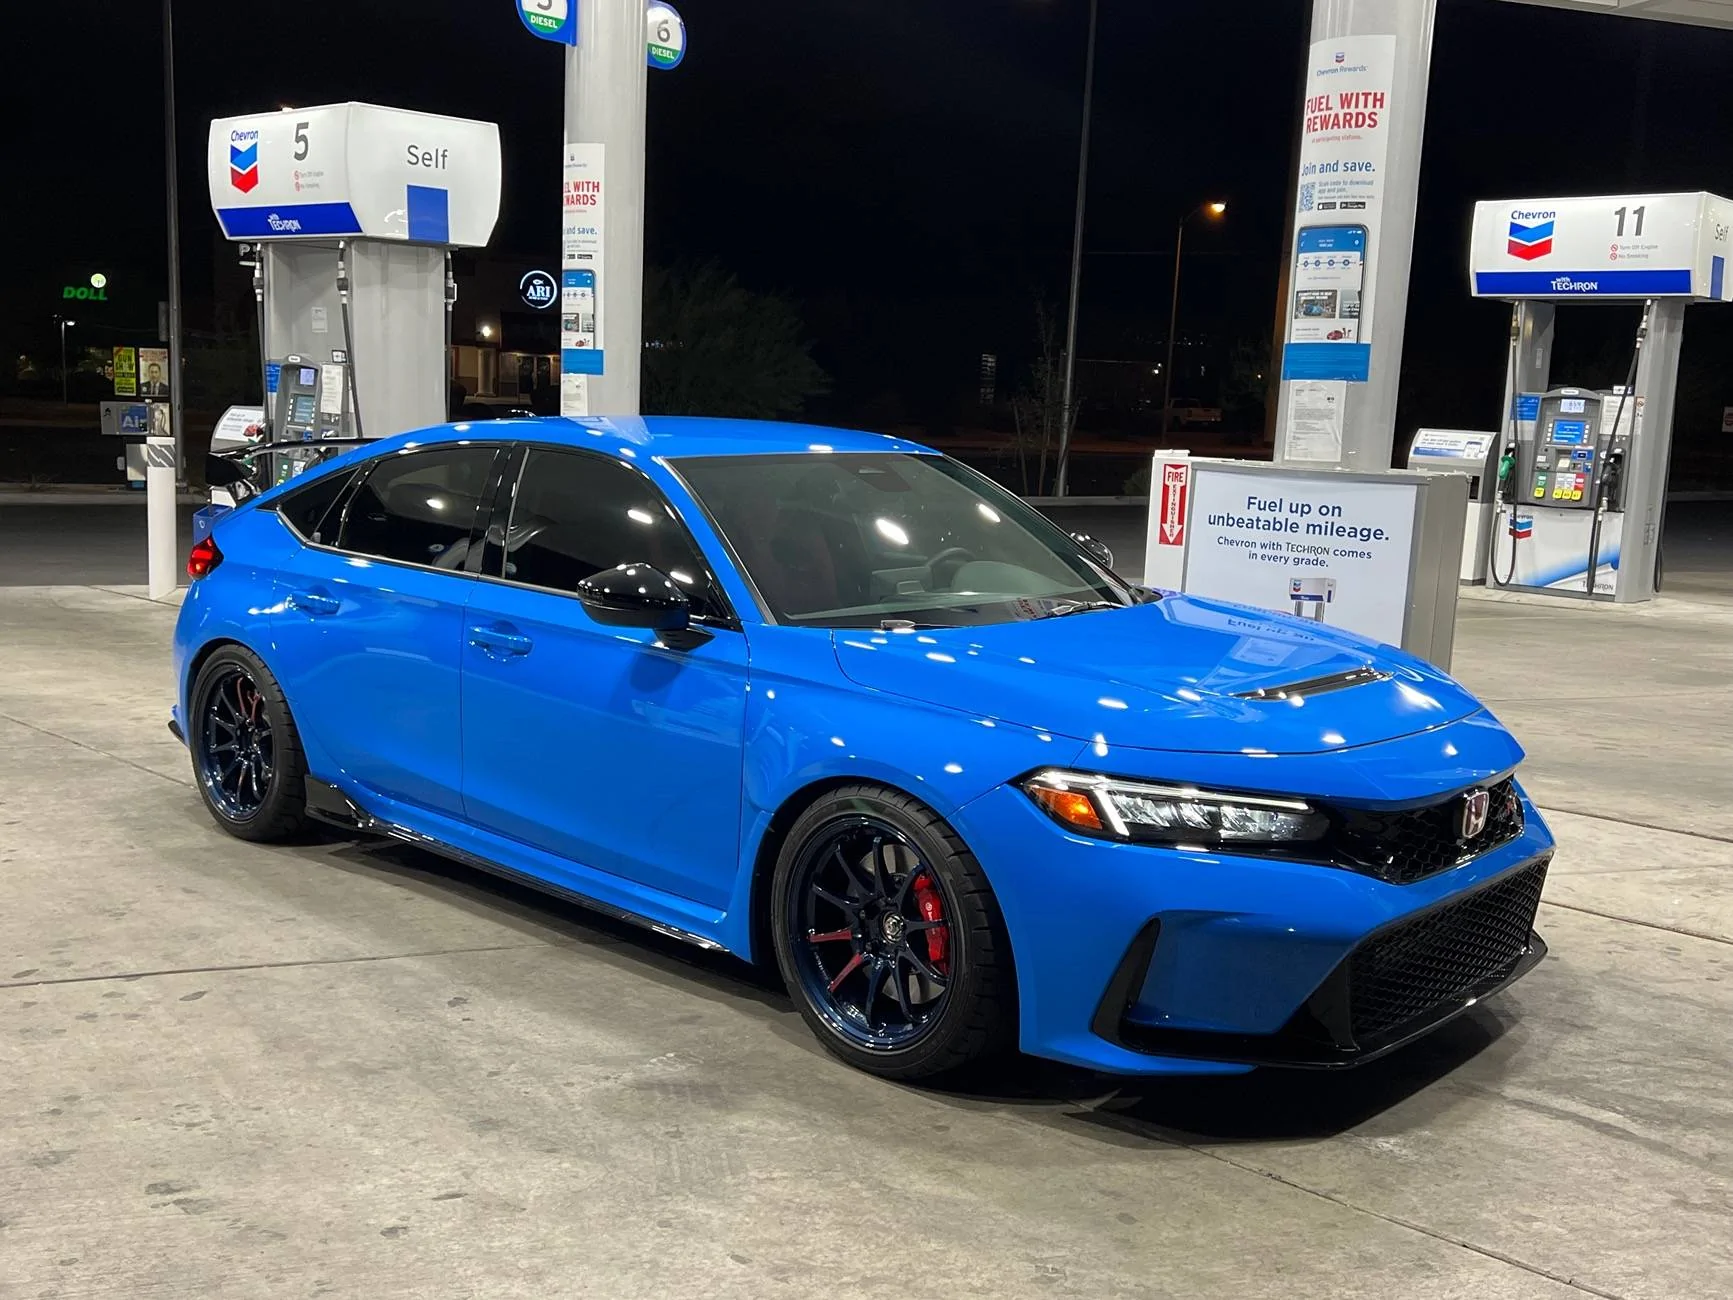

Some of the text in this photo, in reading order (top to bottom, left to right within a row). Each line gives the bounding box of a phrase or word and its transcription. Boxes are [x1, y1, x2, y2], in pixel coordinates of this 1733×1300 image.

[530, 15, 558, 29] DIESEL
[656, 20, 671, 43] 6
[651, 46, 675, 60] DIESEL
[1316, 64, 1367, 77] Chevron Rewards
[1305, 92, 1385, 116] FUEL WITH
[1306, 111, 1379, 134] REWARDS
[230, 130, 259, 142] Chevron
[293, 121, 310, 161] 5
[406, 144, 448, 170] Self
[1301, 160, 1376, 177] Join and save.
[573, 181, 600, 193] WITH
[1510, 210, 1556, 220] Chevron
[1614, 206, 1646, 237] 11
[577, 227, 598, 235] save.
[1714, 223, 1730, 241] Self
[62, 286, 108, 300] DOLL
[526, 285, 551, 298] ARI
[1551, 281, 1598, 292] TECHRON
[1167, 471, 1184, 483] FIRE
[1247, 496, 1342, 518] Fuel up on
[1208, 512, 1390, 543] unbeatable mileage.
[1217, 536, 1373, 560] Chevron with TECHRON comes
[1248, 551, 1329, 568] in every grade.
